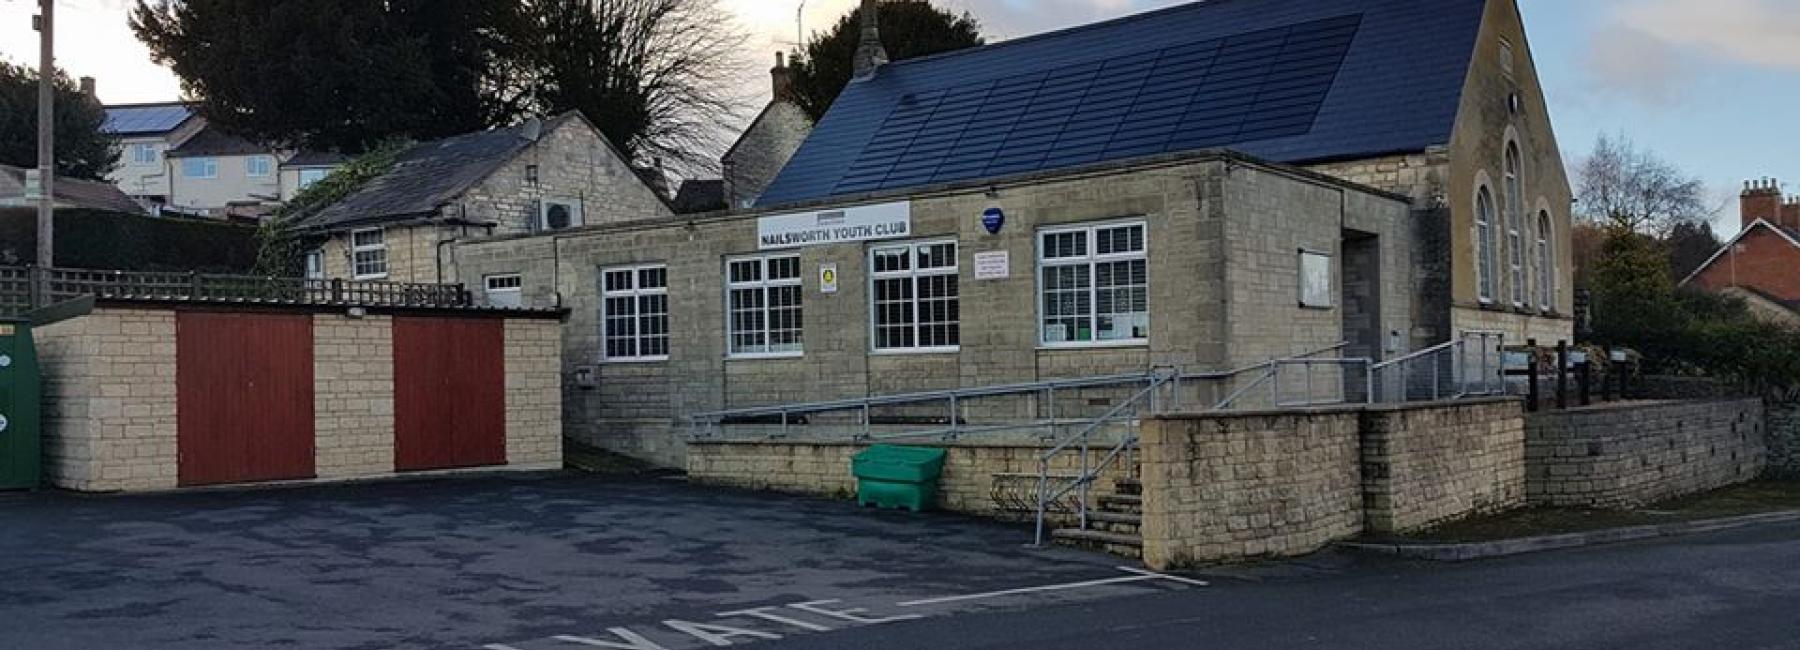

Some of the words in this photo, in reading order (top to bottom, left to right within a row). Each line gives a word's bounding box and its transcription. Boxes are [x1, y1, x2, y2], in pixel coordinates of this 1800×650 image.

[761, 228, 830, 245] NAILSWORTH
[832, 224, 873, 240] YOUTH
[875, 220, 907, 236] CLUB
[483, 598, 922, 650] VATE
